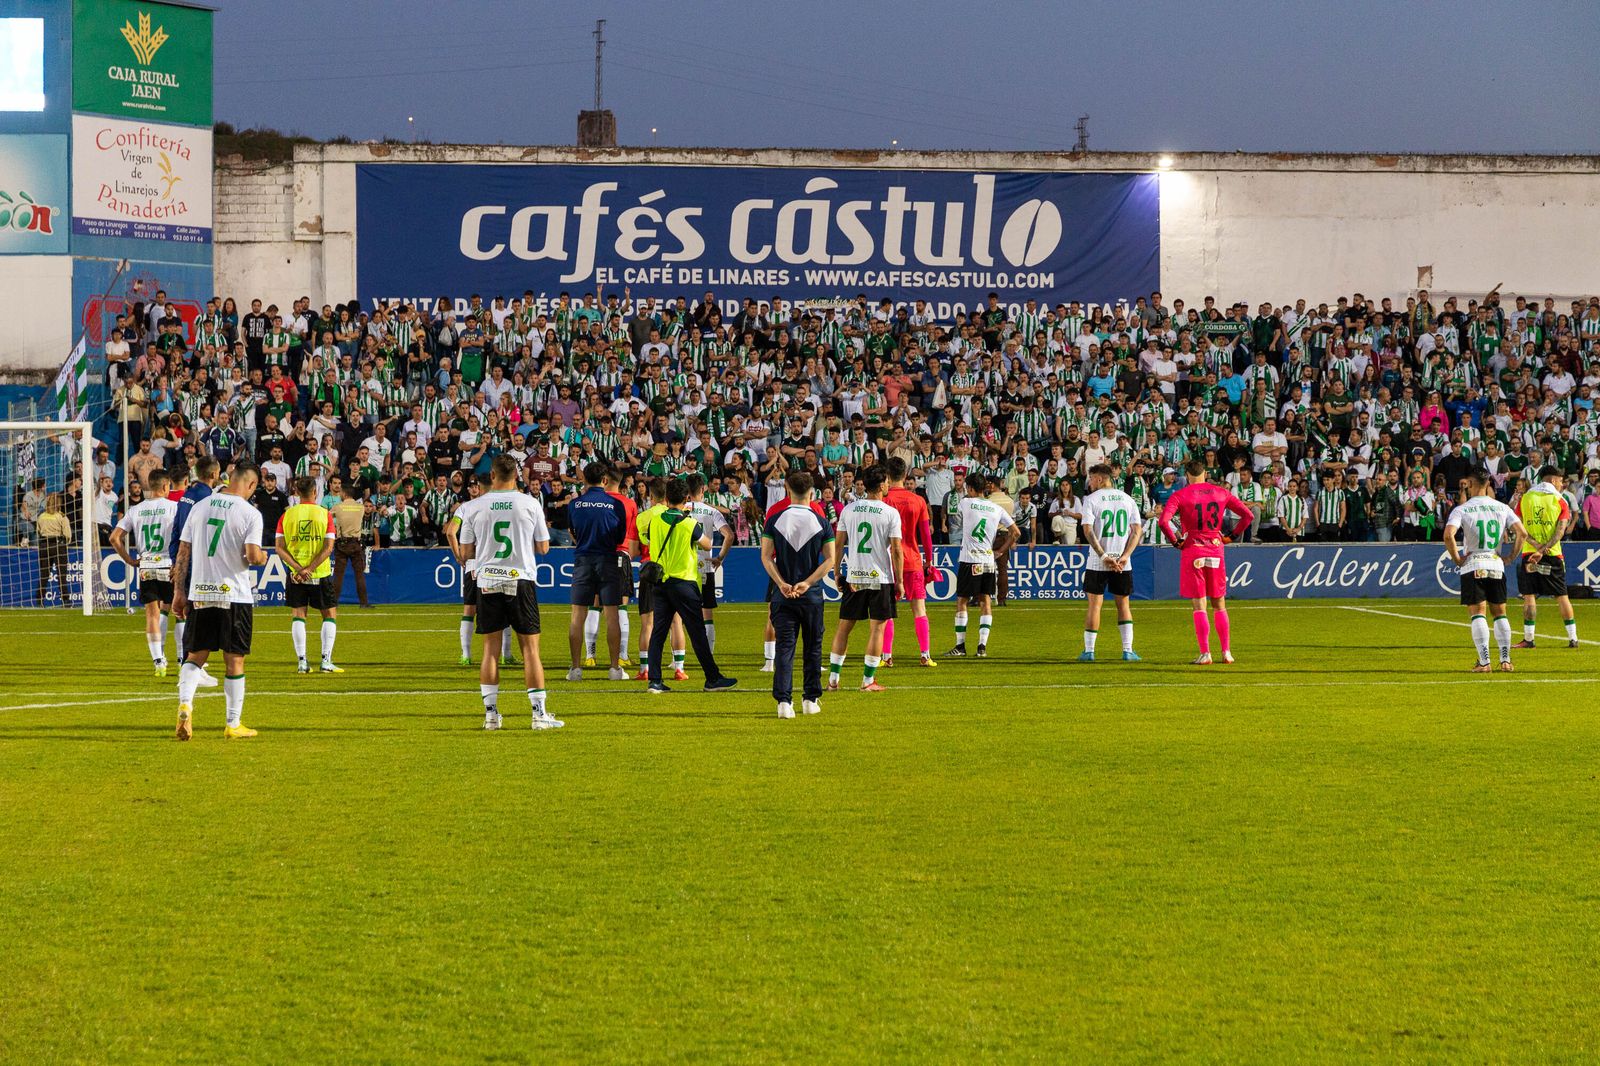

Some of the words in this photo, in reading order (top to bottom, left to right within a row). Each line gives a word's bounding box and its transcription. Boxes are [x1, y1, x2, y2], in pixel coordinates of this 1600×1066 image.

[108, 66, 138, 82] CAJA
[140, 70, 180, 88] RURAL
[131, 84, 162, 100] JAEN
[122, 101, 167, 112] www.ruralvia.com
[95, 127, 192, 161] Confitería
[120, 149, 153, 164] Virgen
[131, 166, 143, 179] de
[115, 180, 159, 198] Linarejos
[97, 184, 188, 219] Panadería
[81, 219, 97, 227] Paseo
[133, 223, 147, 231] Calle
[459, 182, 705, 284] cafés
[596, 268, 620, 284] EL
[624, 263, 673, 285] CAFÉ
[678, 267, 703, 285] DE
[709, 268, 790, 286] LINARES
[804, 269, 1055, 289] WWW.CAFESCASTULO.COM
[210, 499, 234, 510] WILLY
[490, 501, 513, 511] JORGE
[868, 506, 883, 515] RUIZ
[1101, 508, 1128, 538] 20
[1194, 501, 1220, 531] 13
[141, 522, 165, 553] 15
[207, 517, 225, 557] 7
[493, 521, 513, 559] 5
[856, 521, 872, 554] 2
[971, 518, 988, 543] 4
[1475, 519, 1500, 550] 19
[484, 567, 507, 576] PIEDRA
[1272, 547, 1416, 599] Galería
[130, 591, 138, 601] 6
[195, 584, 219, 592] PIEDRA
[1019, 590, 1032, 599] 38
[1037, 590, 1057, 599] 653
[1058, 590, 1071, 599] 78
[1072, 590, 1086, 599] 06
